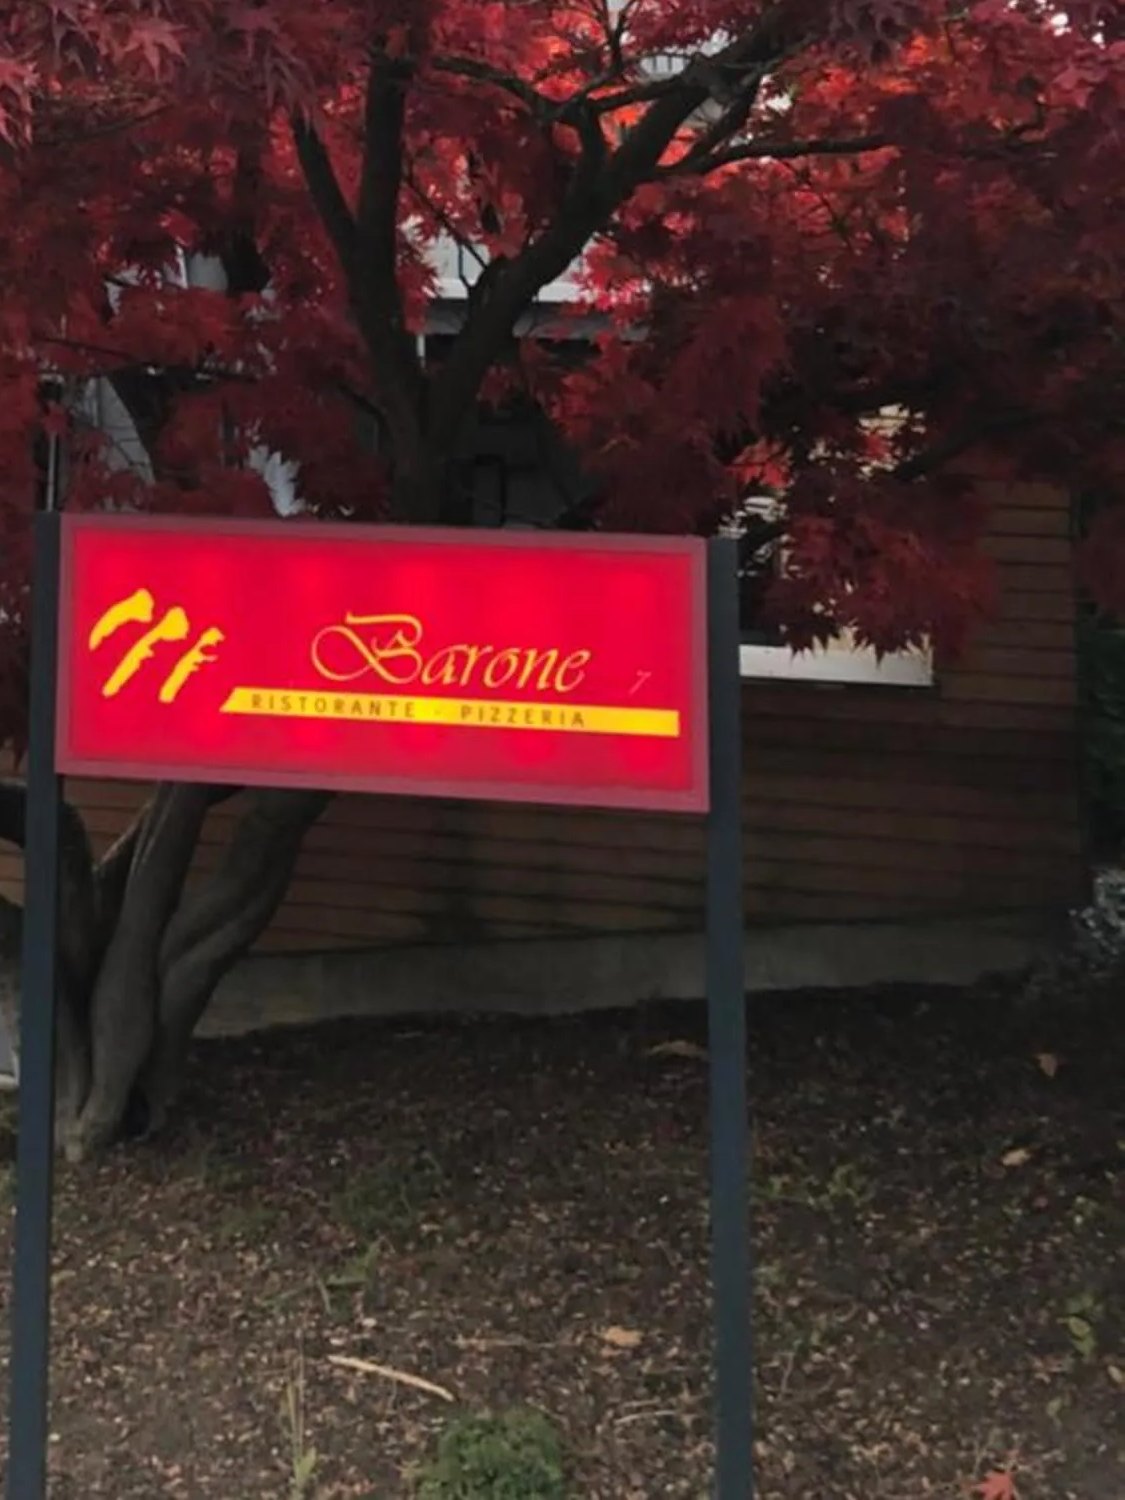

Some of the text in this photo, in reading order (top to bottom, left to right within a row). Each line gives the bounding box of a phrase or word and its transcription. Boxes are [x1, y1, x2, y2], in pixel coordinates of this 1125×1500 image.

[312, 612, 591, 692] Barone
[251, 694, 416, 718] RISTORANTE
[461, 705, 585, 727] PIZZERIA
